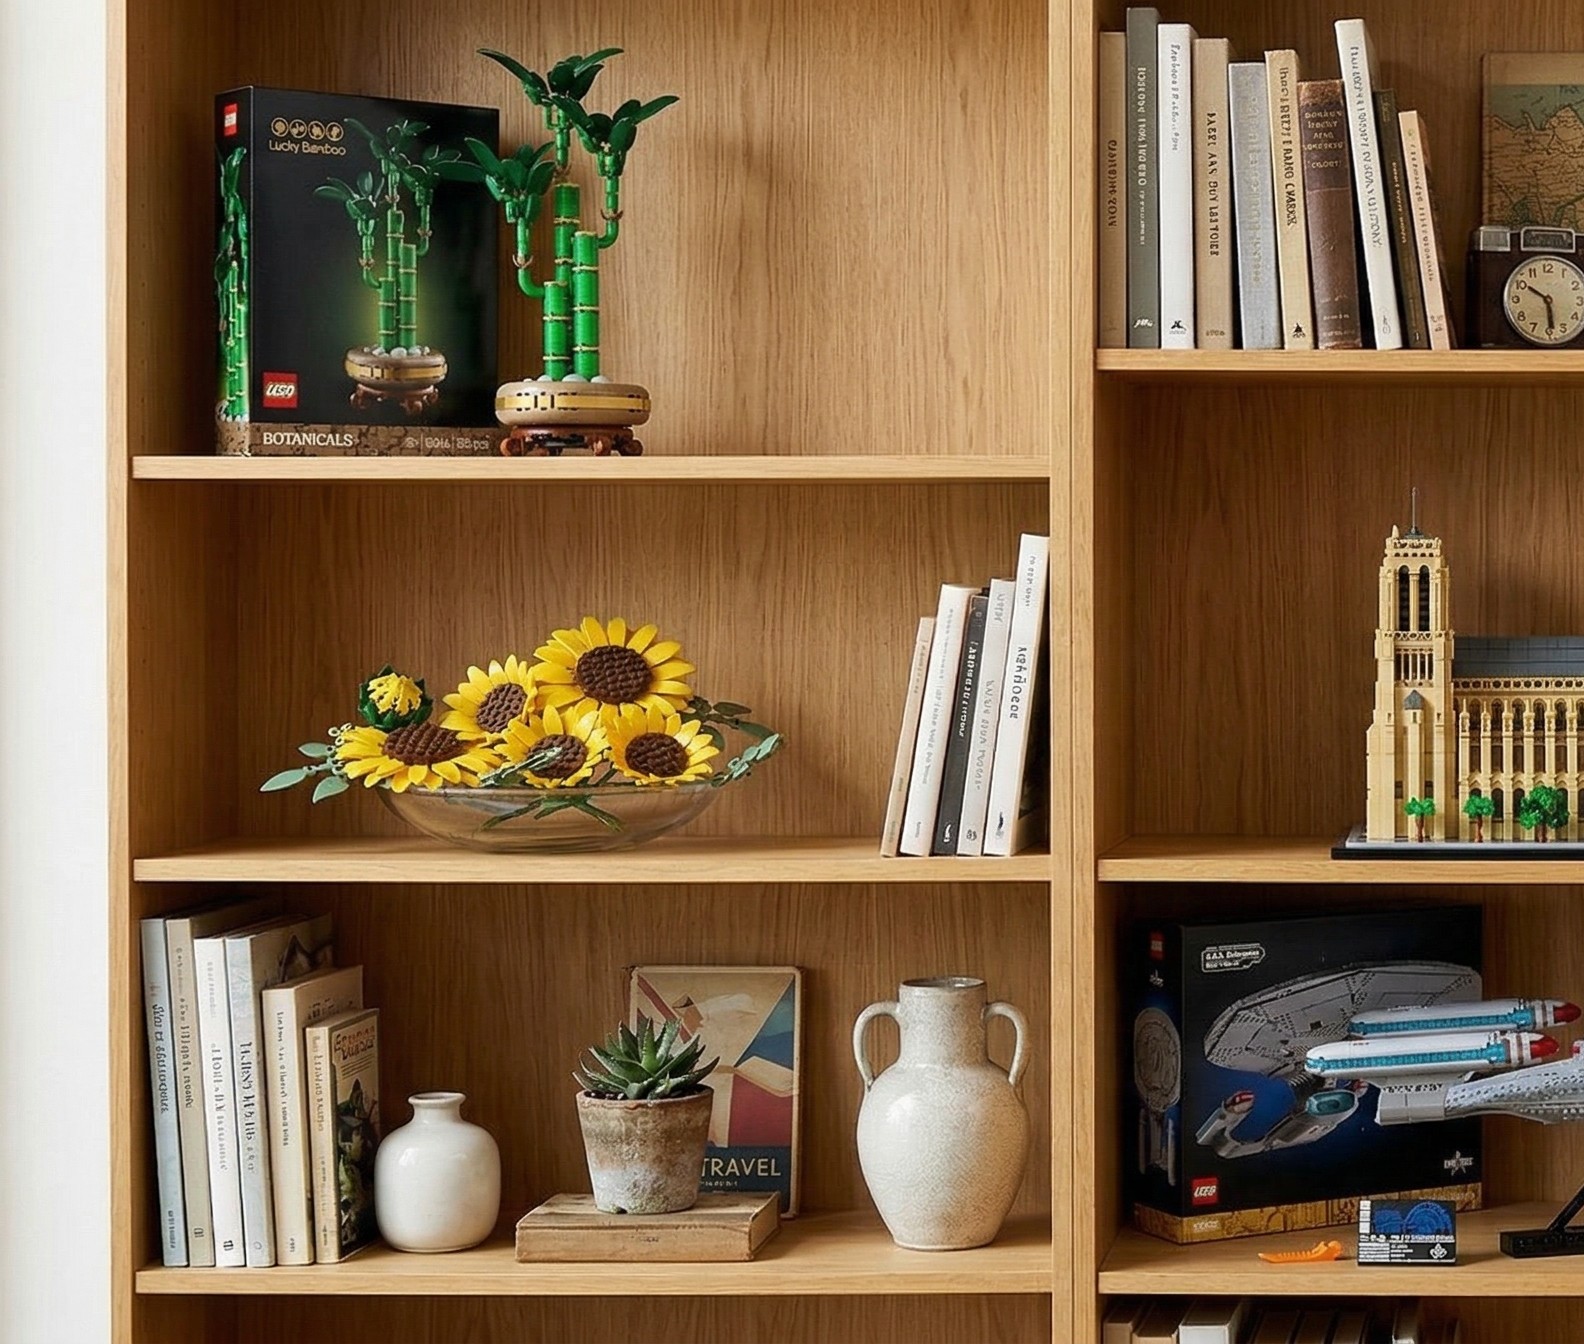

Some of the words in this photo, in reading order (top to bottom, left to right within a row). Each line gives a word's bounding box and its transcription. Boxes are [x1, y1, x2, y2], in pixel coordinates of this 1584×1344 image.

[269, 140, 300, 154] Lucky
[1528, 268, 1537, 279] 11
[1543, 264, 1554, 274] 12
[1515, 280, 1528, 291] 10
[1571, 280, 1580, 291] 2
[1576, 296, 1584, 307] 3
[1517, 311, 1527, 322] 8
[1570, 312, 1579, 321] 4
[1529, 322, 1538, 333] 7
[263, 432, 354, 447] BOTANICALS
[701, 1158, 782, 1177] TRAVEL
